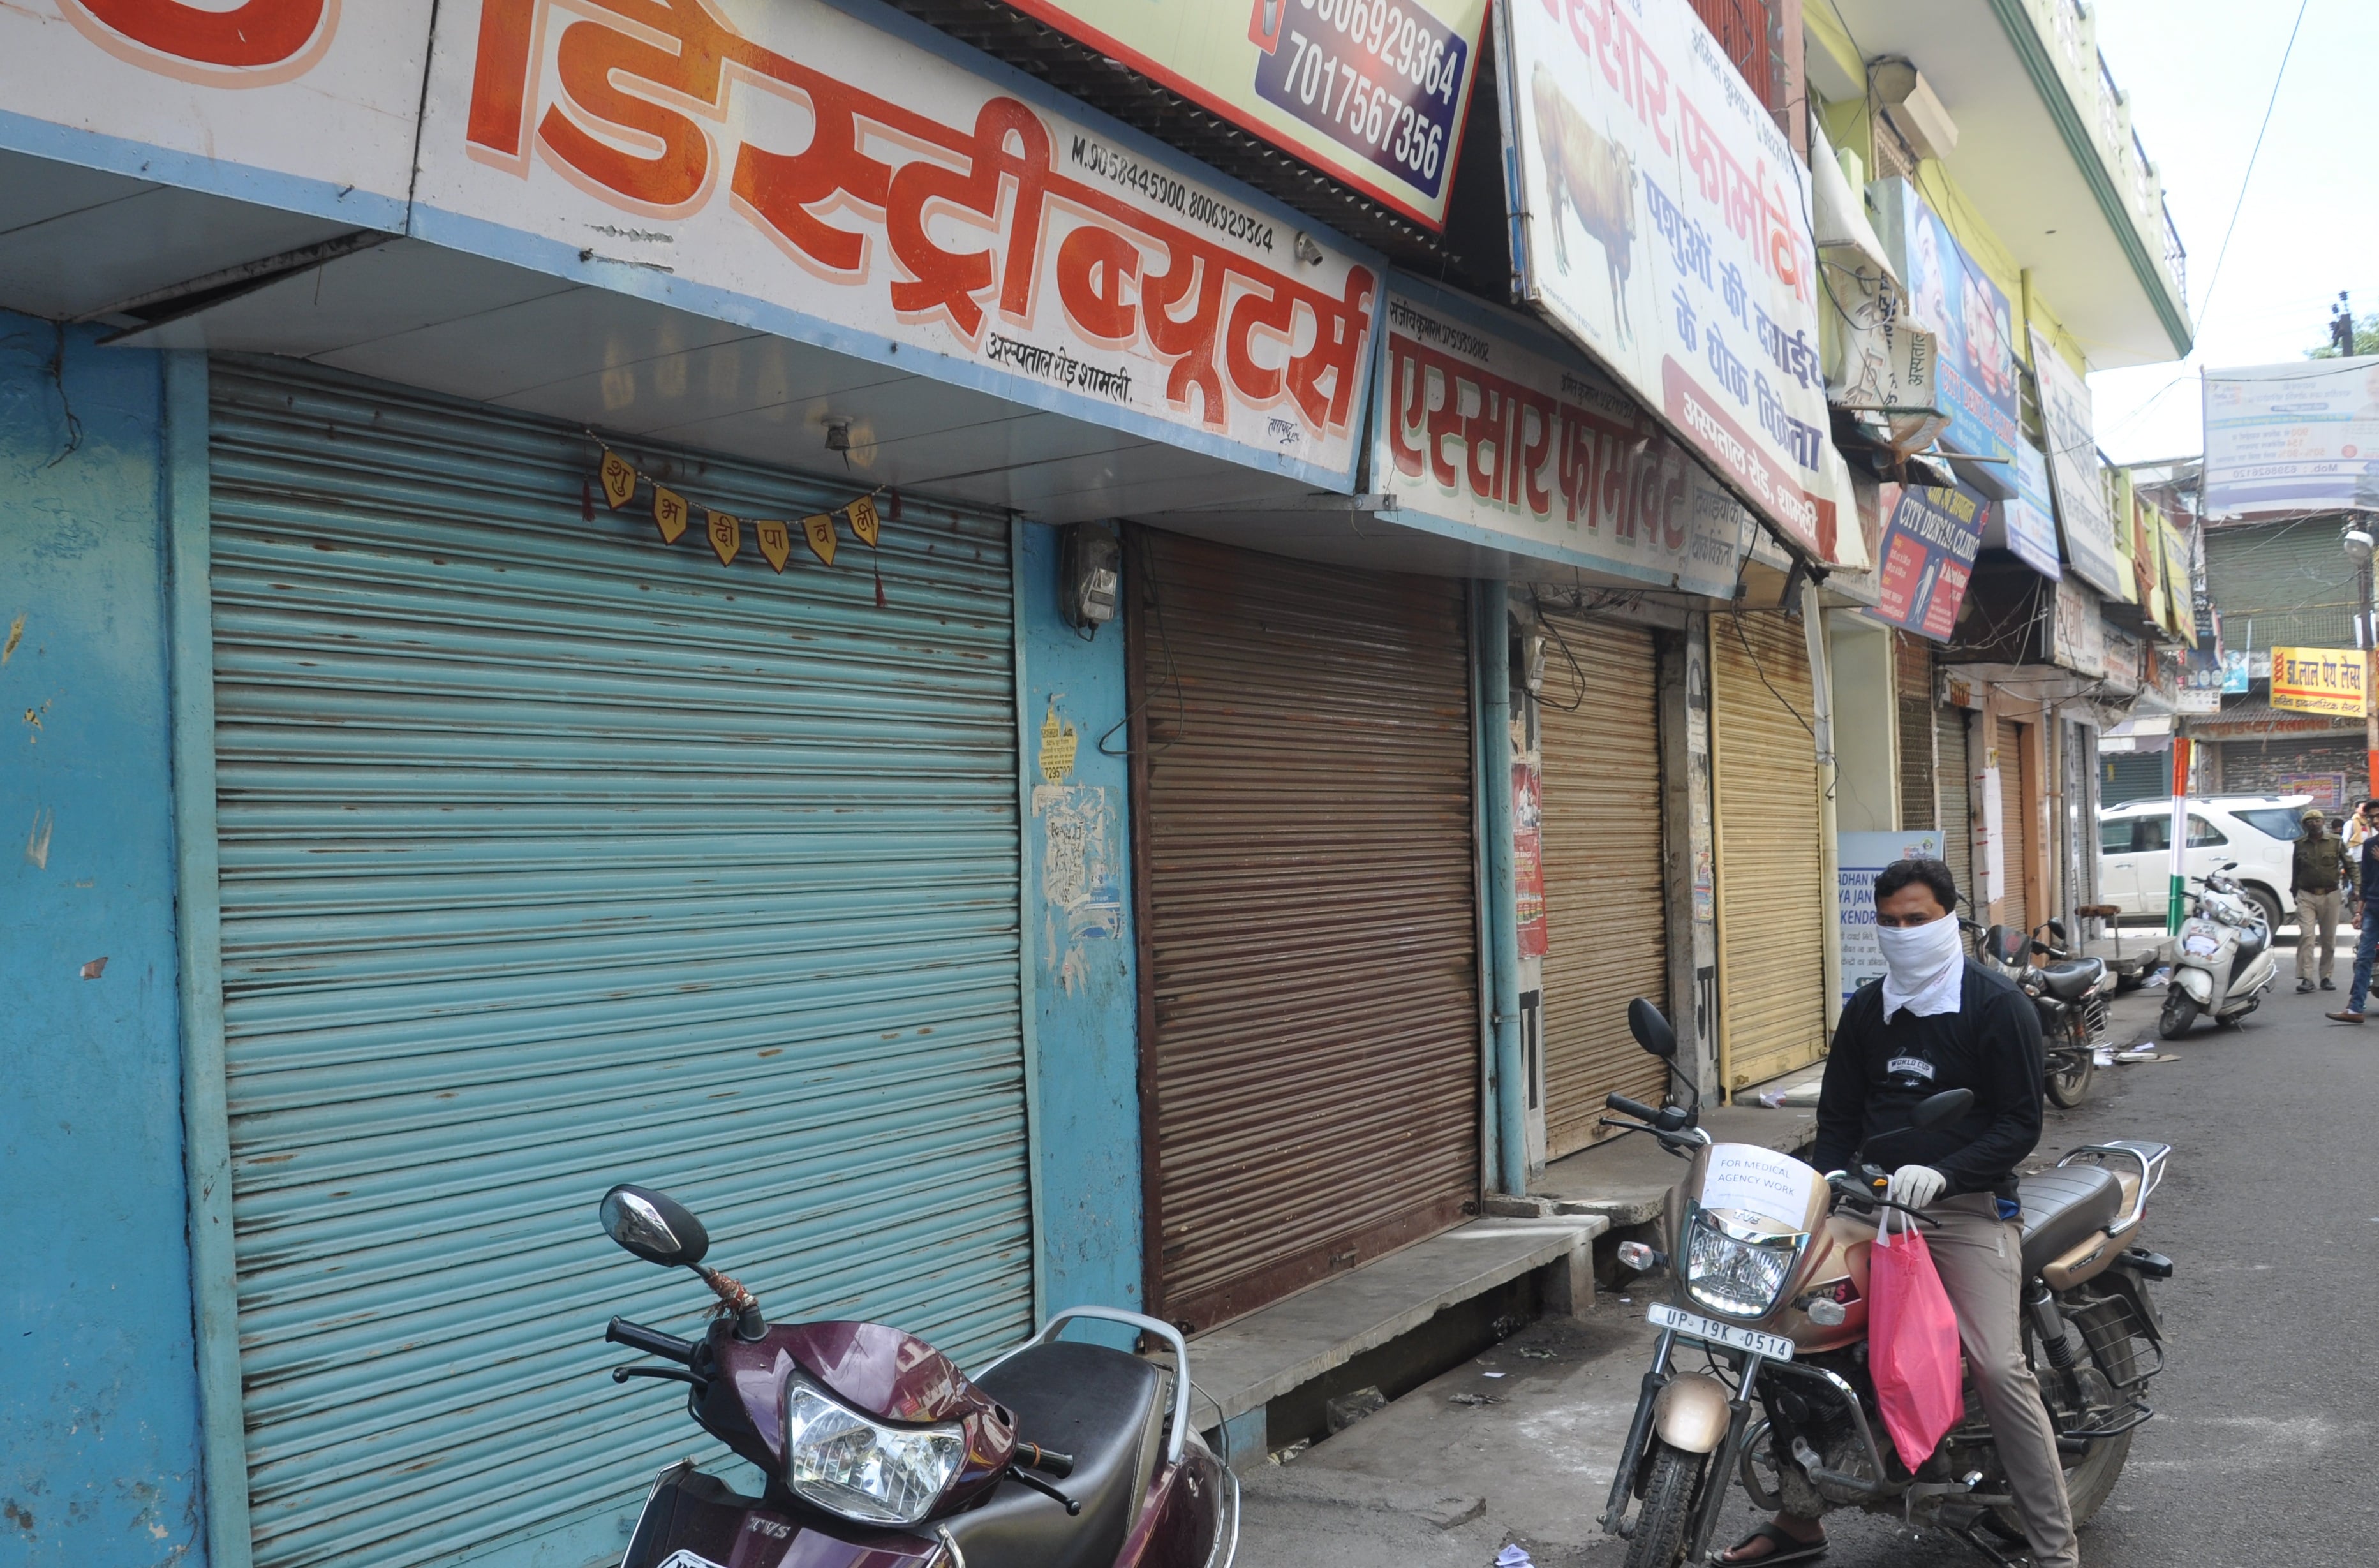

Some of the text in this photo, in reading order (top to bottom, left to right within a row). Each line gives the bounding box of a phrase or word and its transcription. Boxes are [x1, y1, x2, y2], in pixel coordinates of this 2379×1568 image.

[1284, 29, 1442, 180] 7017567356
[1189, 194, 1274, 253] 8006929364
[1642, 168, 1714, 293] पशुओं
[1718, 258, 1749, 333] की
[1671, 282, 1698, 353] के
[985, 331, 1055, 380] अस्पताल
[1055, 345, 1078, 389] रोड
[1388, 331, 1558, 516] एस्सार
[1683, 391, 1747, 476] अस्पताल
[1777, 484, 1818, 541] शामली
[1899, 496, 1925, 532] CITY
[1920, 510, 1957, 550] DENTAL
[1953, 528, 1981, 563] CLINIC
[1853, 889, 1872, 906] JAN
[1891, 1059, 1916, 1067] WORLD
[1917, 1061, 1930, 1071] CUP
[1717, 1174, 1795, 1197] AGENCY WORK
[1720, 1158, 1791, 1180] FOR MEDICAL
[1733, 1211, 1760, 1225] TVS
[1666, 1310, 1788, 1356] UP 19K 0514
[746, 1515, 792, 1539] TVS
